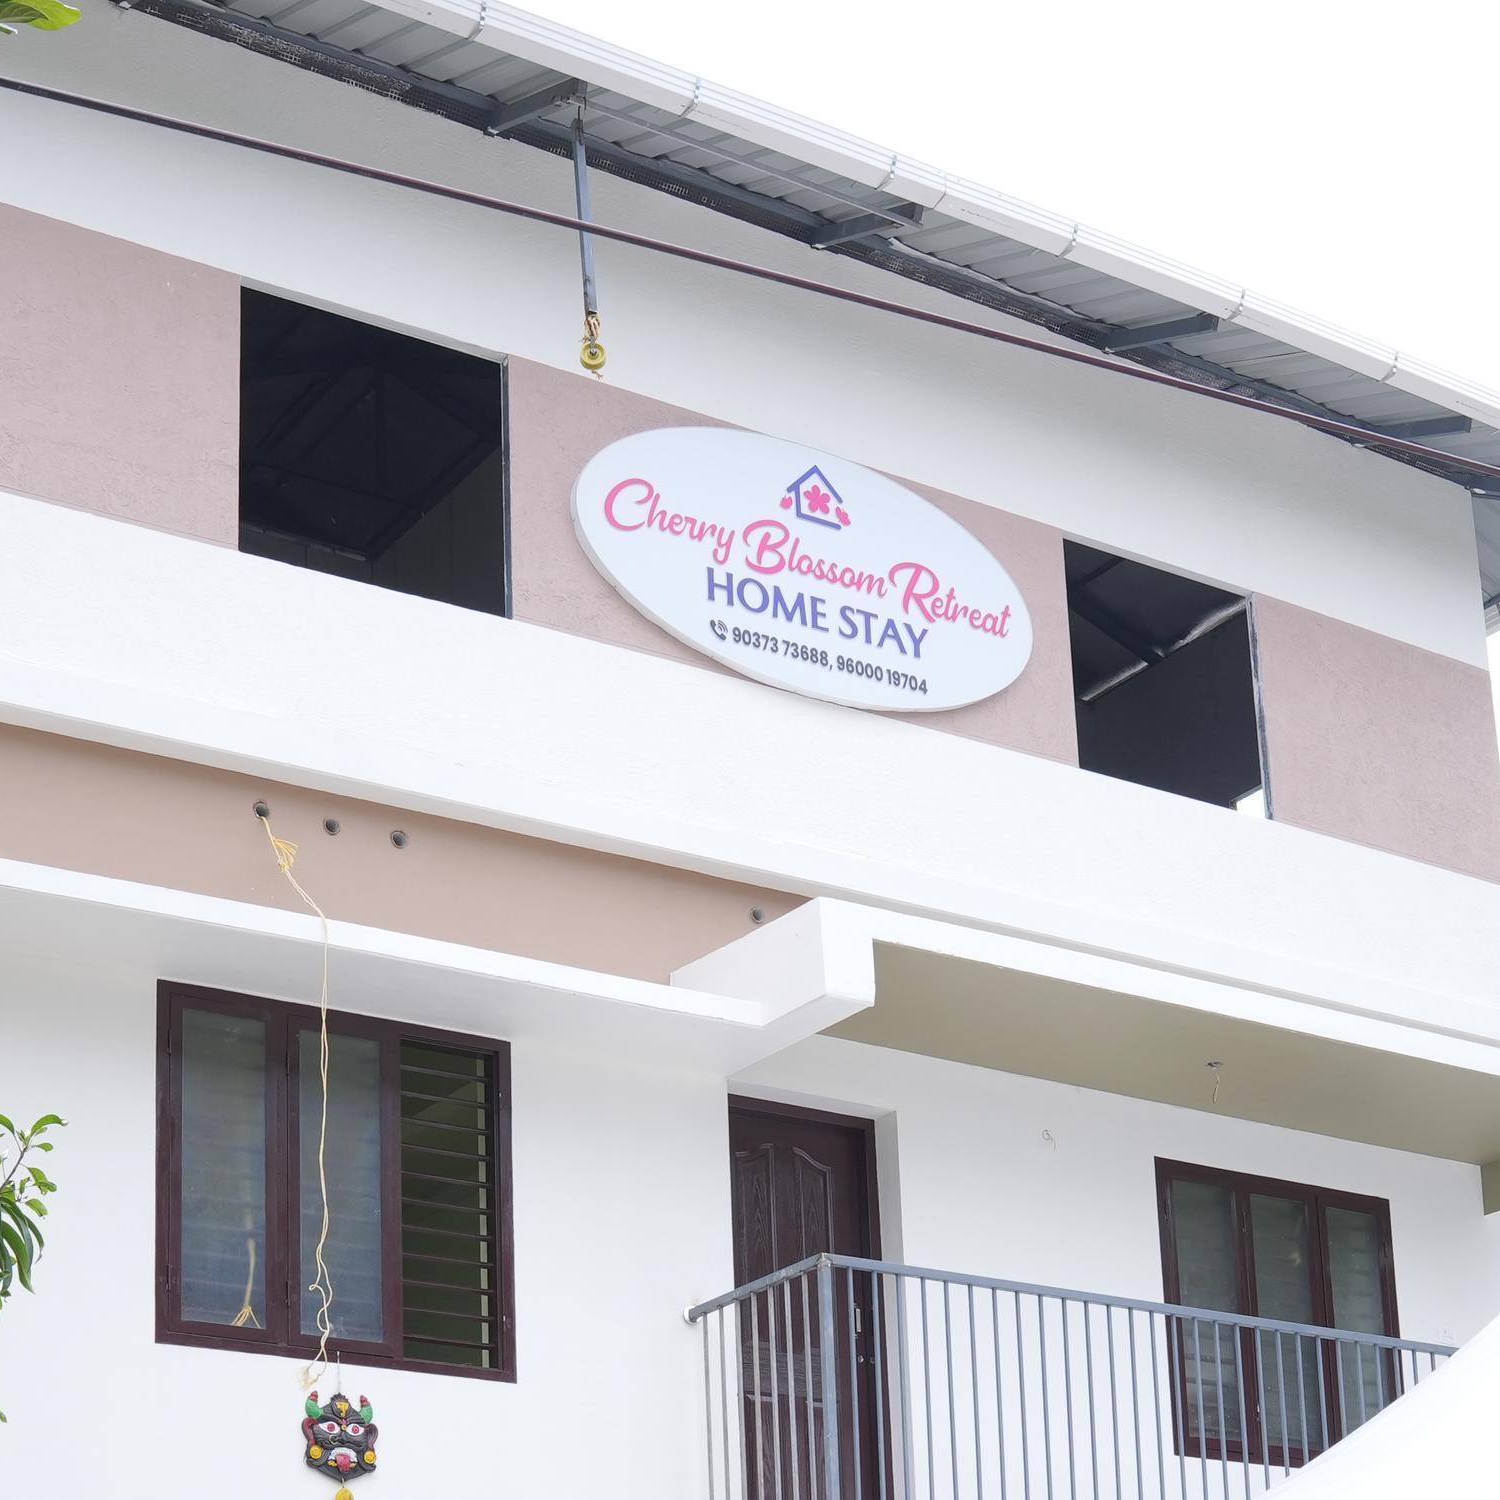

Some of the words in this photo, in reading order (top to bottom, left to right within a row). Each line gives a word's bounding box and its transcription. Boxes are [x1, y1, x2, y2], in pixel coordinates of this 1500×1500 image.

[604, 478, 735, 565] Cherry
[743, 519, 888, 598] Blossom
[888, 562, 1011, 638] Retreat
[706, 567, 830, 633] HOME
[838, 605, 928, 658] STAY
[732, 627, 779, 653] 90373
[782, 640, 833, 671] 73688,
[837, 655, 883, 682] 96000
[886, 668, 928, 694] 19704
